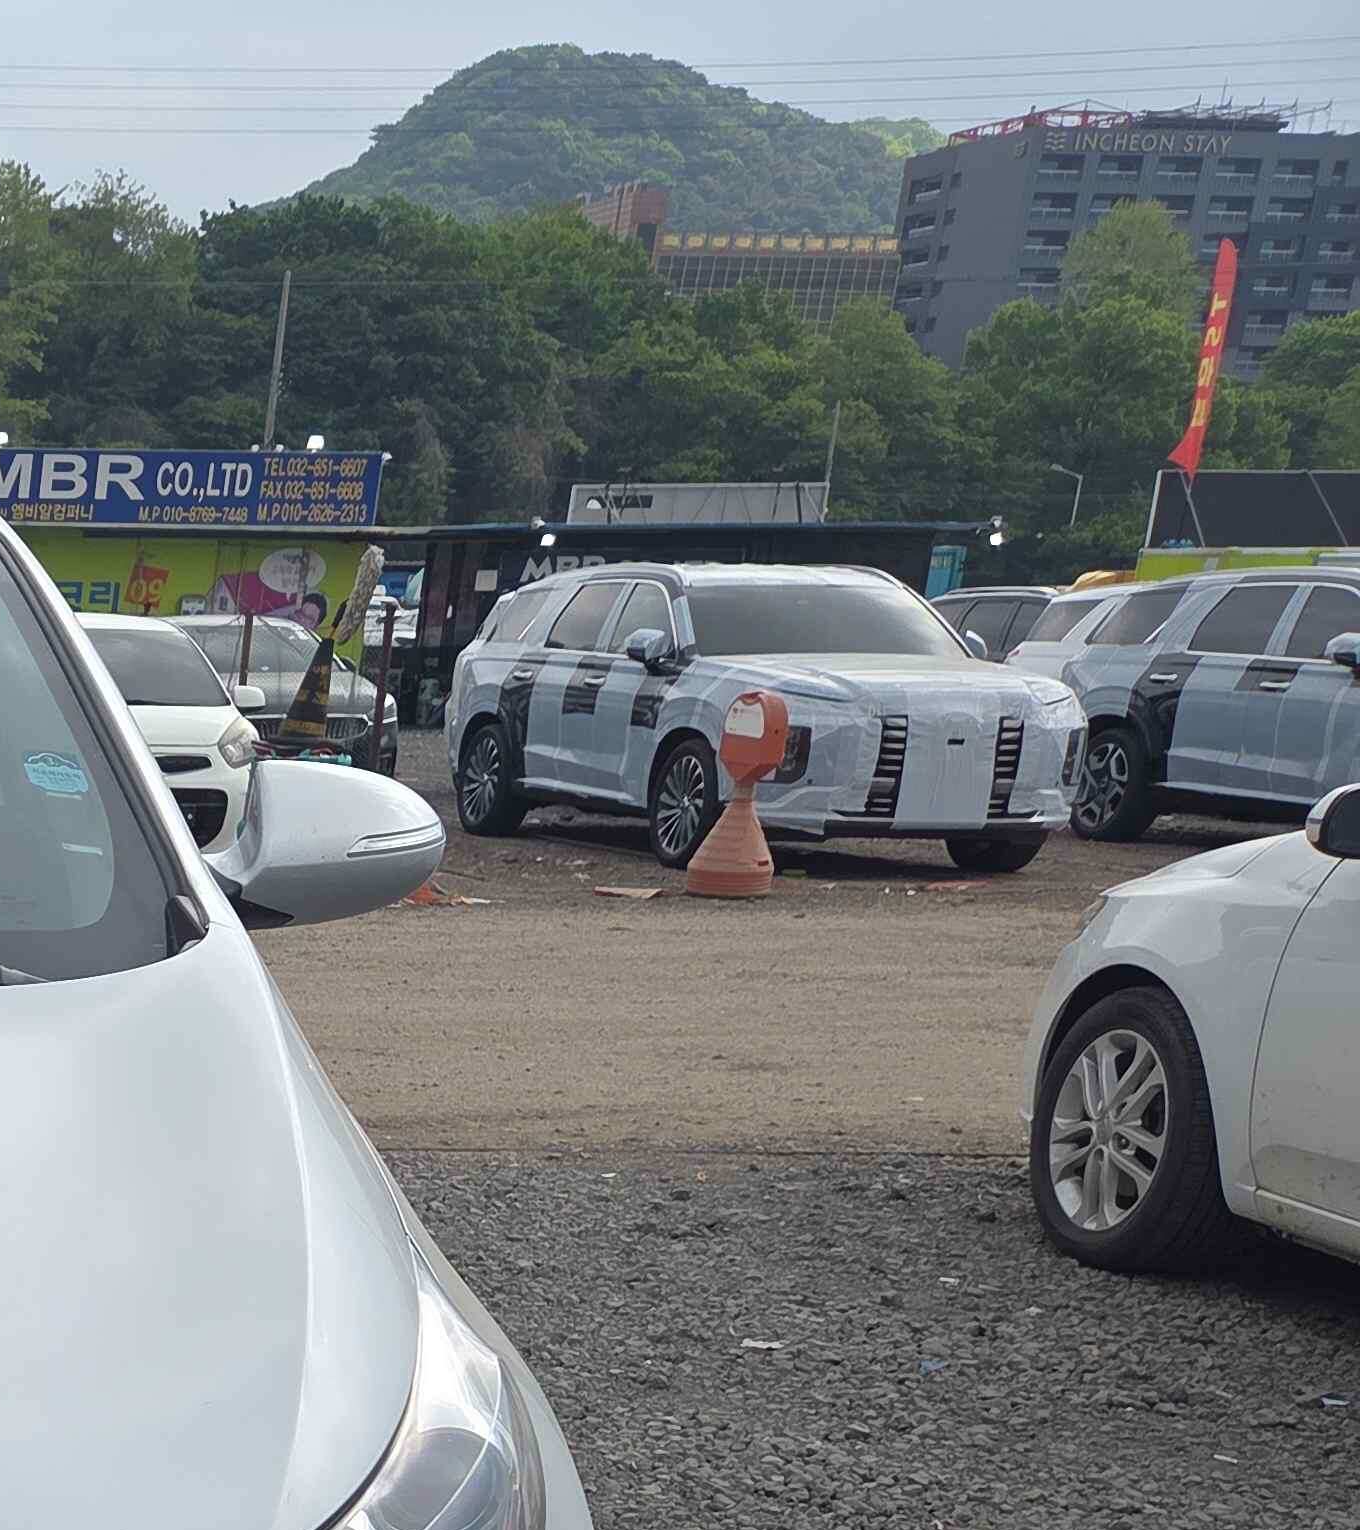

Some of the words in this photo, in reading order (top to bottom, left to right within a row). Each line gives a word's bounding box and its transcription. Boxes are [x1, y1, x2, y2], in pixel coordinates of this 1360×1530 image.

[1074, 131, 1175, 152] INCHEON
[1183, 134, 1231, 153] STAY
[156, 461, 253, 502] CO.,LTD
